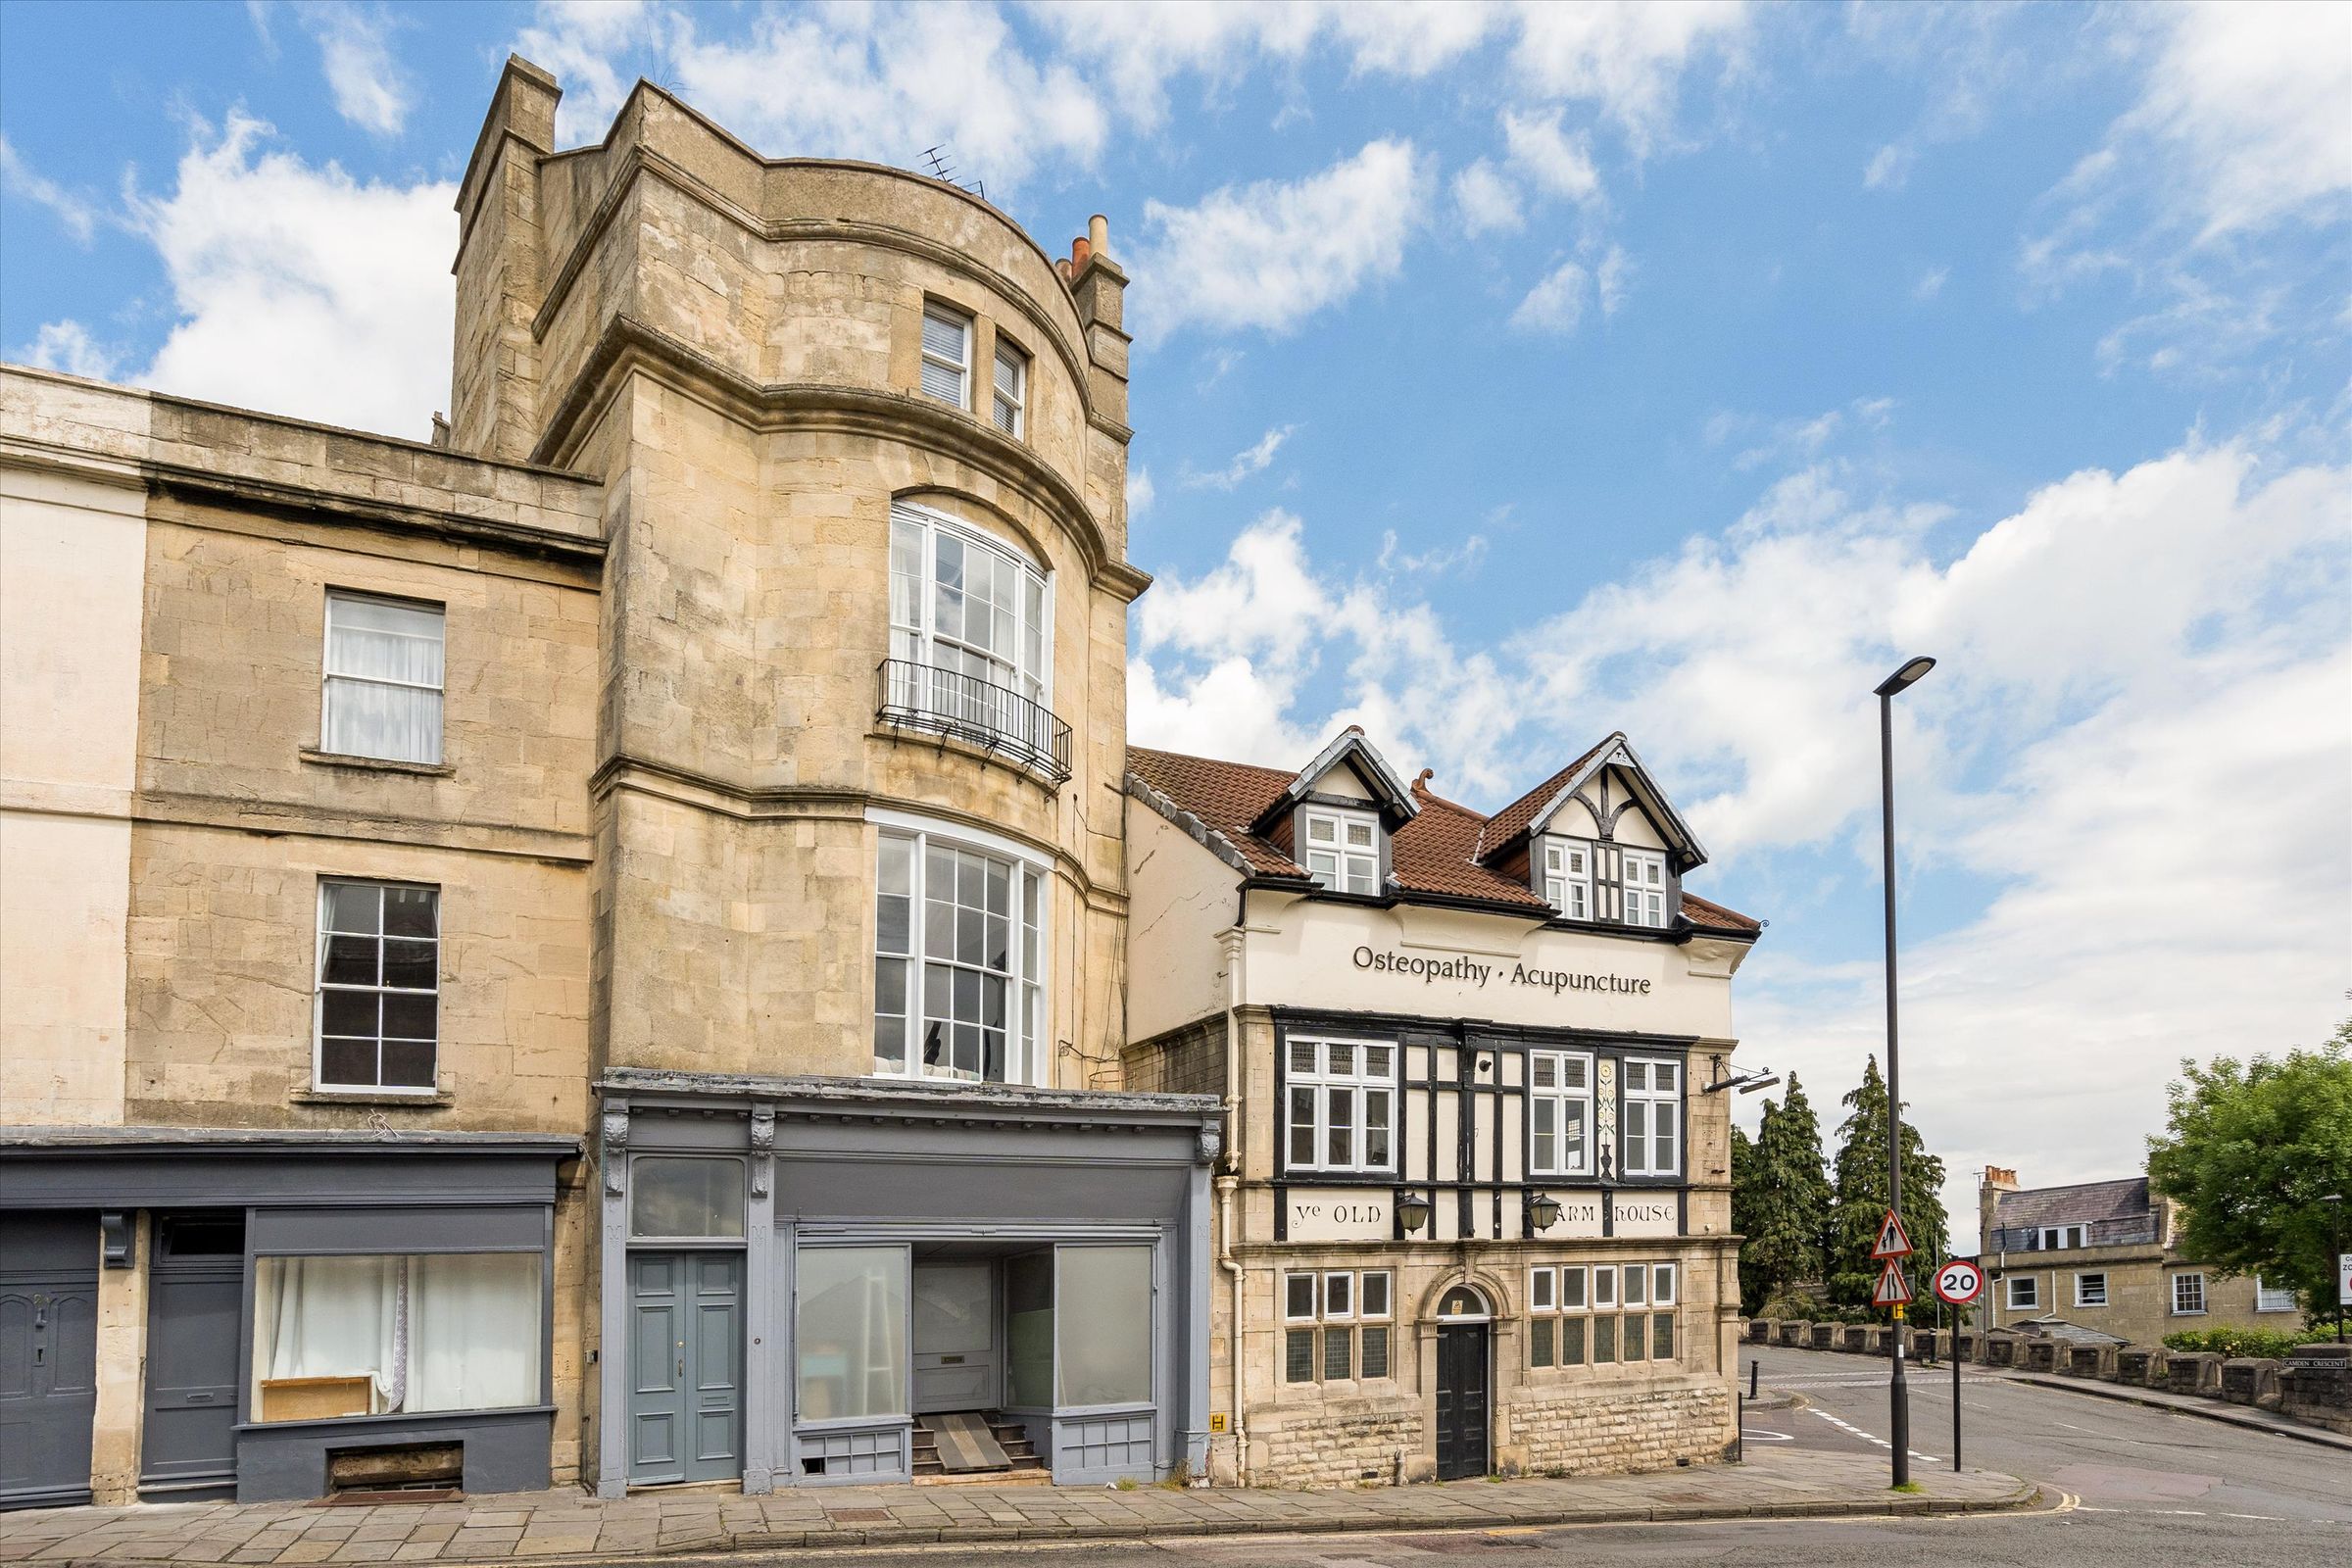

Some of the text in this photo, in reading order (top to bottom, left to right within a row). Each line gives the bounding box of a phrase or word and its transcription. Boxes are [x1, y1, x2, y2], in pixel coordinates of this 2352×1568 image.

[1353, 946, 1651, 995] Osteopathy Acupuncture
[1334, 1205, 1381, 1223] OLD
[1554, 1205, 1594, 1222] ARM
[1943, 1274, 1975, 1291] 20
[1212, 1415, 1224, 1430] H
